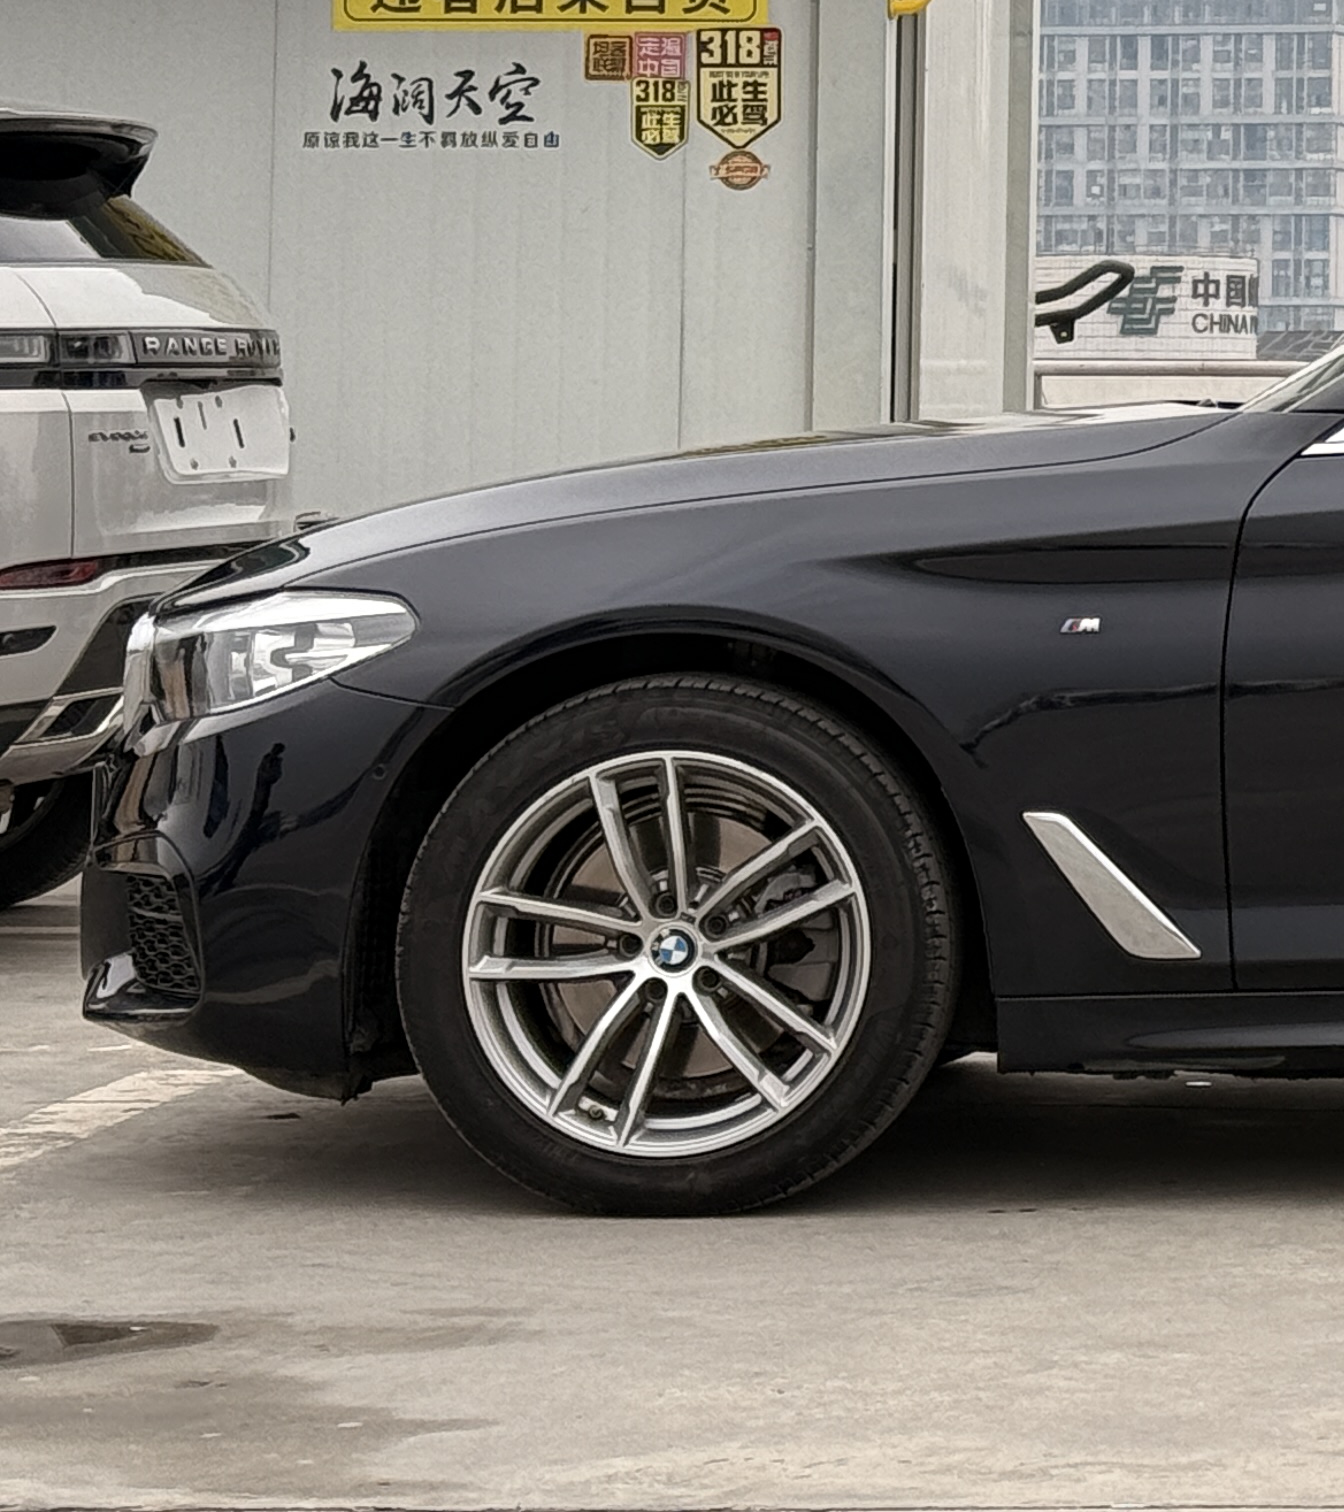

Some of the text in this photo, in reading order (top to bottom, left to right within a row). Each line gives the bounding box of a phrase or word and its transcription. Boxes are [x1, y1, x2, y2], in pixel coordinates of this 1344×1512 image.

[700, 30, 761, 65] 318
[330, 60, 541, 125] 海阔天空
[635, 79, 675, 103] 318
[711, 79, 768, 103] 此生
[143, 336, 226, 356] RANGE
